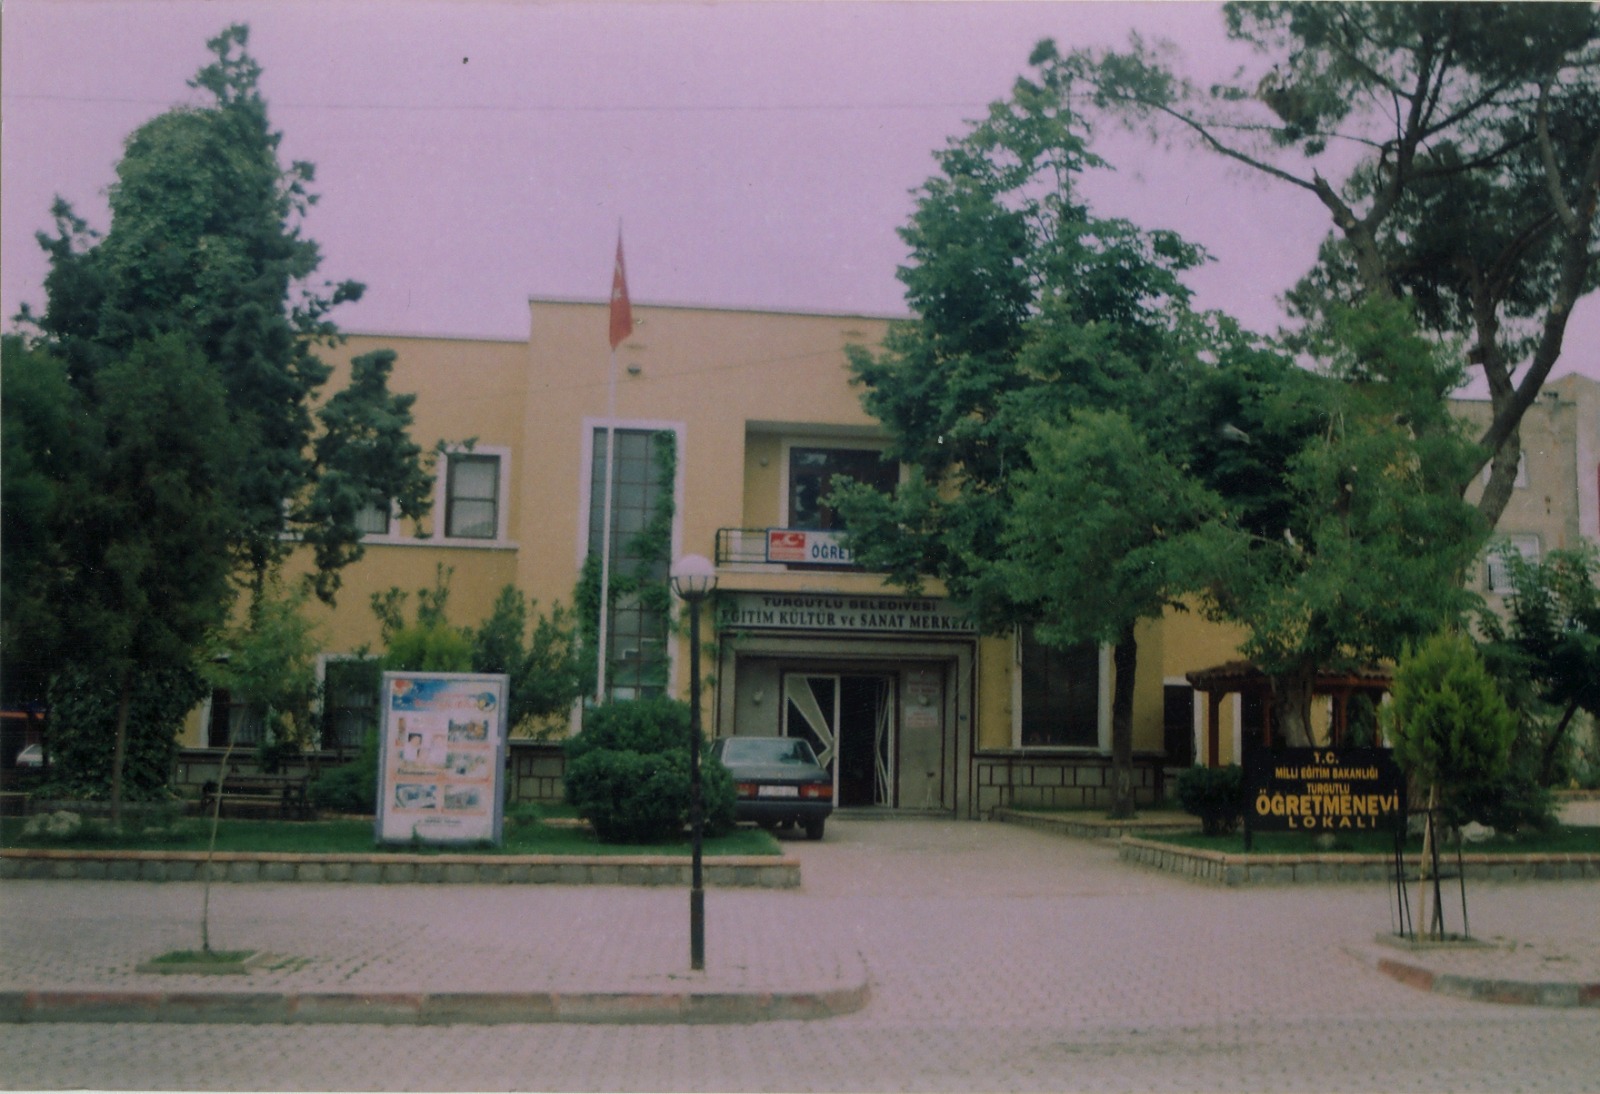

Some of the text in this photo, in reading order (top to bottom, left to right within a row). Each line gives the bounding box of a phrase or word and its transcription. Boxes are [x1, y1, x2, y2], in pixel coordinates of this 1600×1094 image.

[860, 614, 906, 628] SANAT
[1313, 751, 1339, 765] T.C.
[1306, 782, 1350, 795] TURGUTLU
[1255, 788, 1399, 816] ÖĞRETMENEVİ
